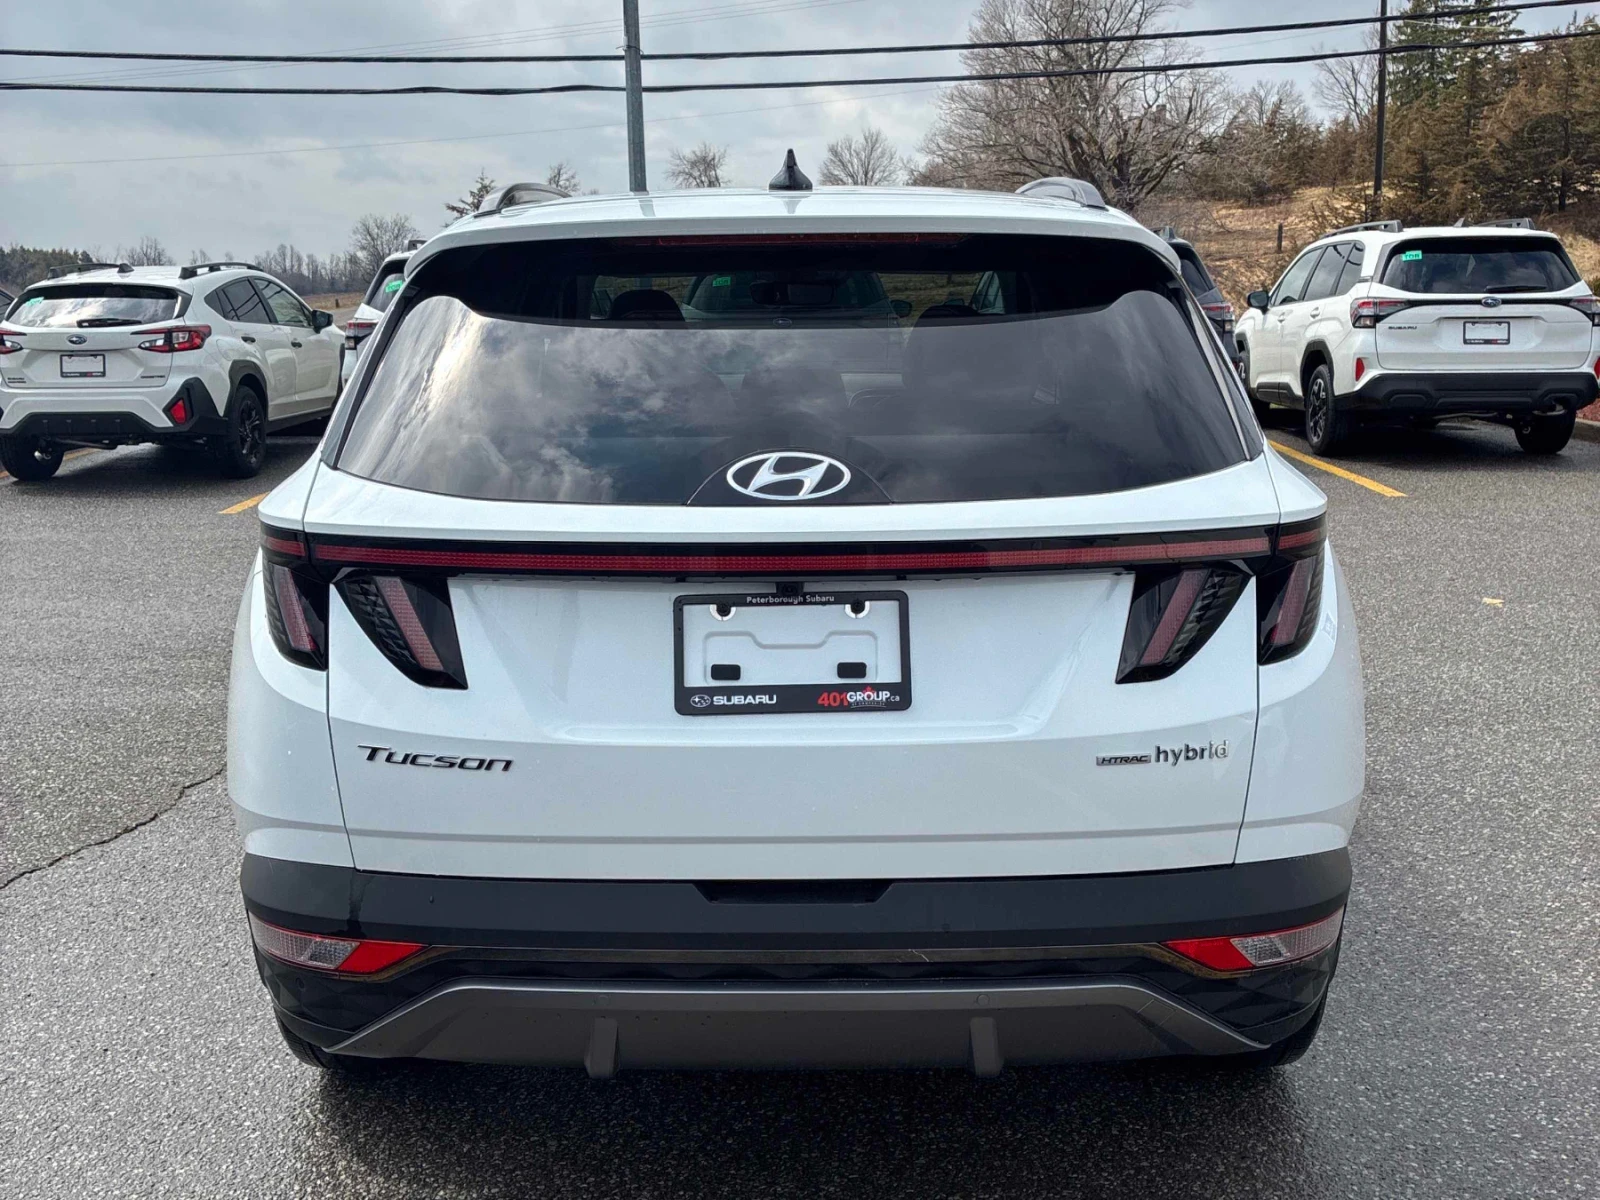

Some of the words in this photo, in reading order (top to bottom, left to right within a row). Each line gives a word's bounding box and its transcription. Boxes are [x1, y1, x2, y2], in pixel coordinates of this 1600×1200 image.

[746, 595, 804, 605] Peterborough
[805, 594, 835, 603] Subaru
[712, 694, 777, 706] SUBARU
[1100, 754, 1149, 764] HTRAC
[1154, 739, 1229, 767] hybrid
